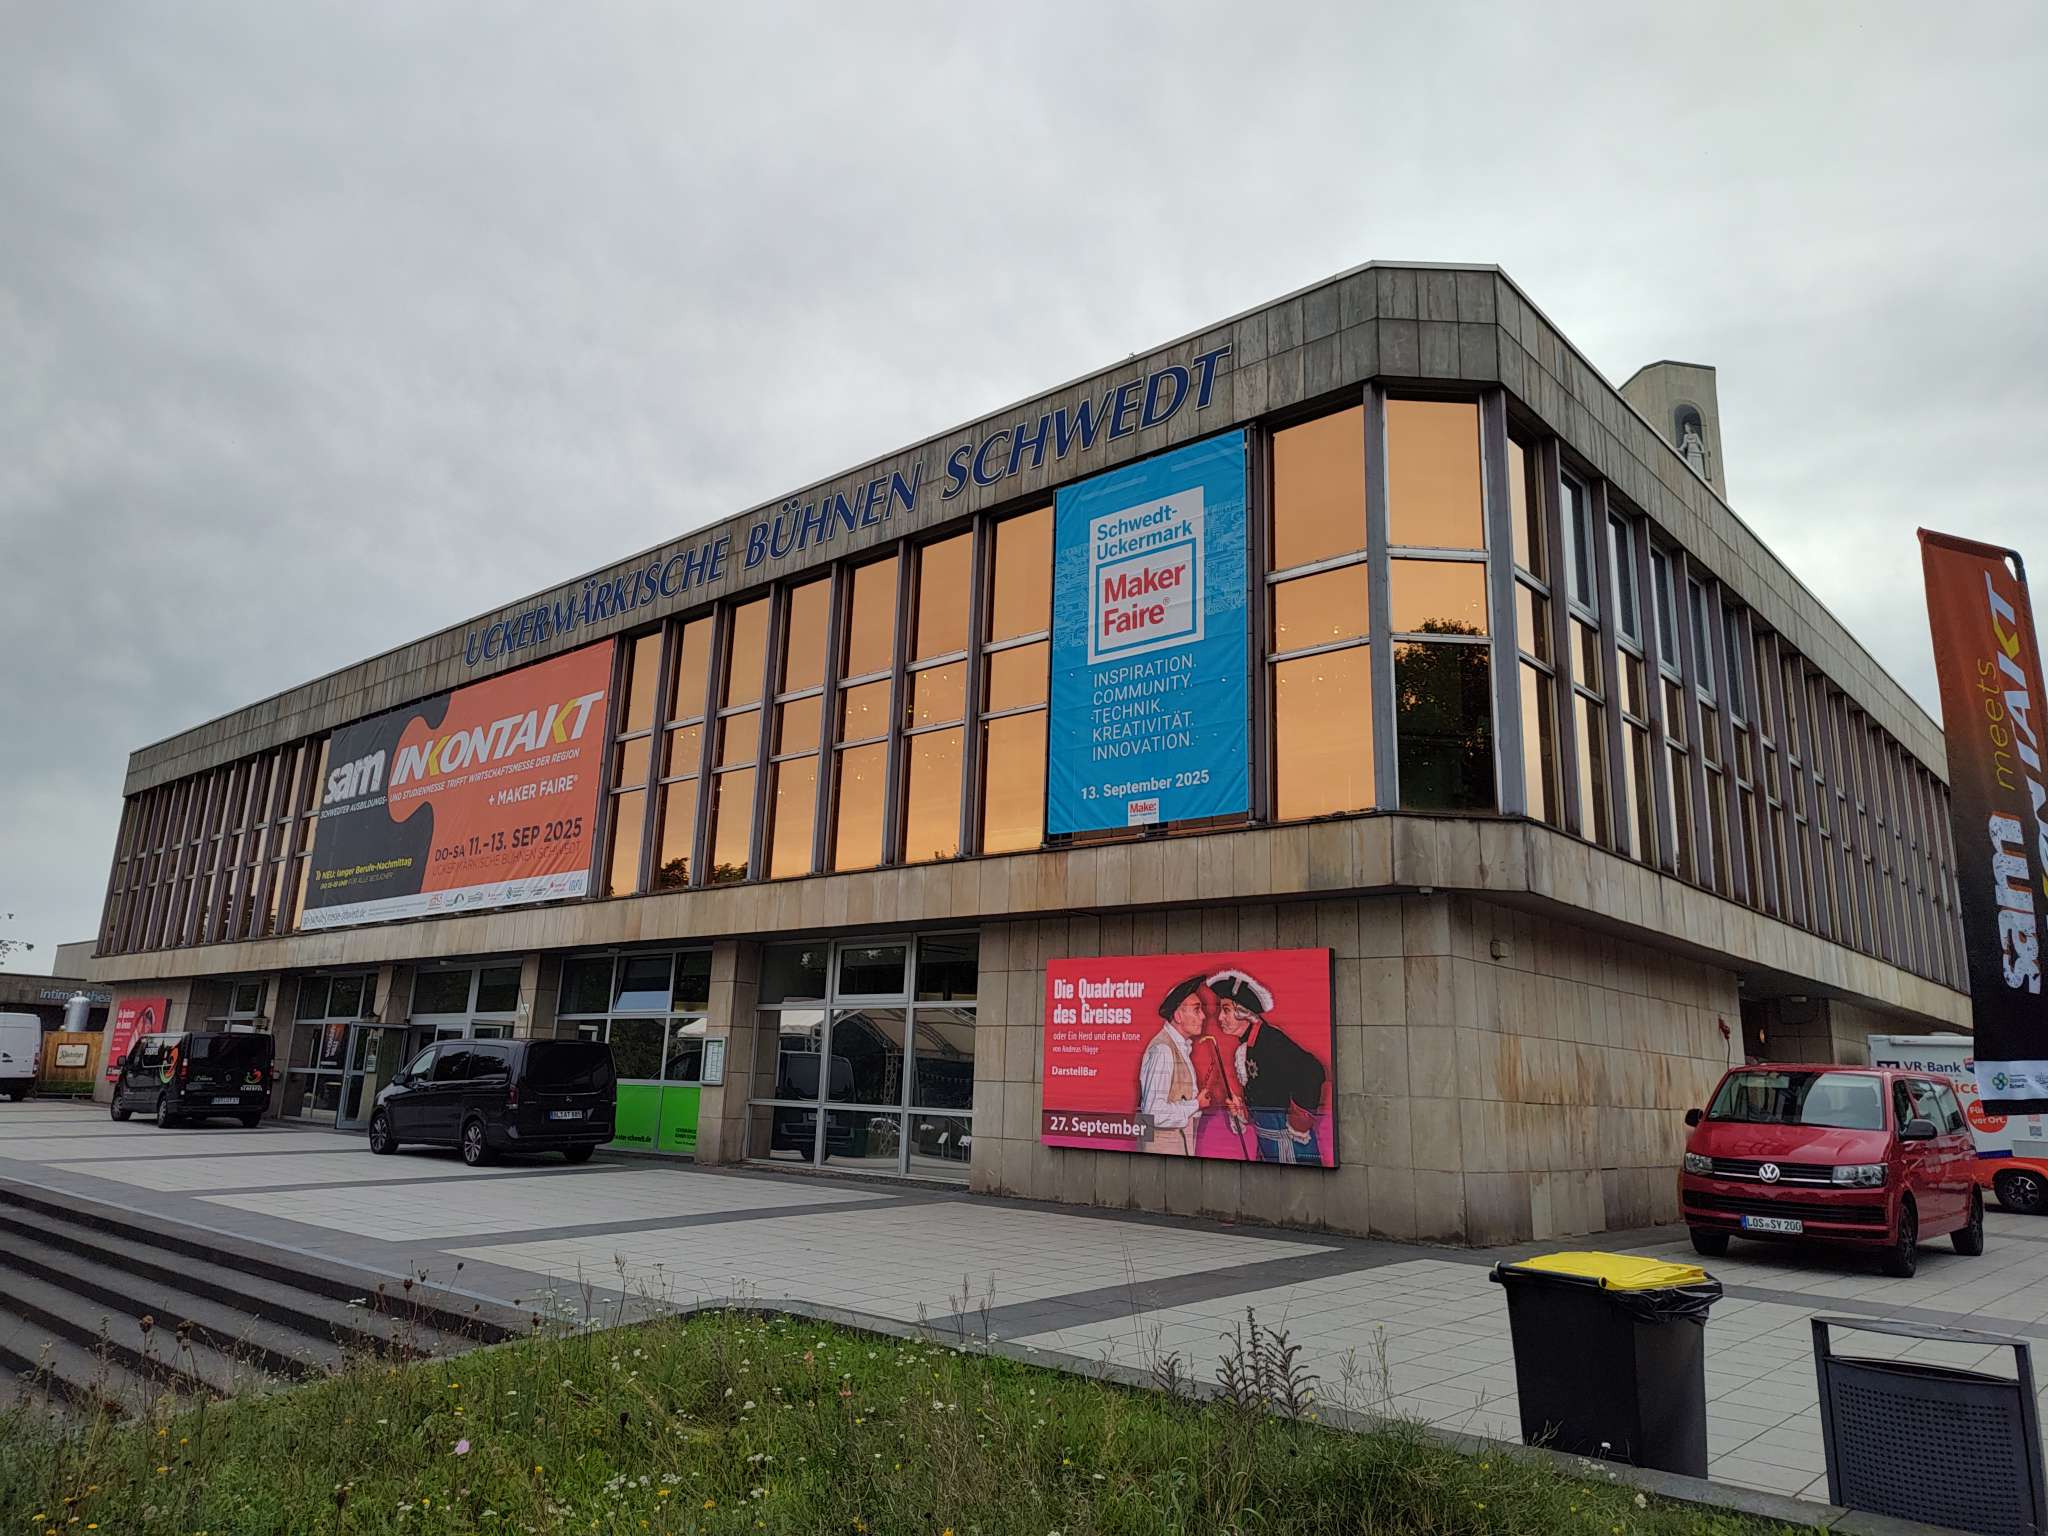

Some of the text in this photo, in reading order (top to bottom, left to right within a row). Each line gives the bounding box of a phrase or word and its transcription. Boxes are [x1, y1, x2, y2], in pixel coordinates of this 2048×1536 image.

[464, 343, 1232, 667] UCKERMÄRKISCHE BÜHNEN SCHWEDT
[1097, 504, 1177, 541] Schwedt-
[1096, 520, 1192, 560] Uckermark
[1104, 563, 1186, 604] Maker
[1094, 653, 1196, 688] INSPIRATION.
[1093, 672, 1193, 706] COMMUNITY.
[1093, 698, 1164, 724] TECHNIK.
[1093, 710, 1194, 742] KREATIVITÄT.
[390, 690, 605, 787] INKONTAKT
[1093, 731, 1194, 761] INNOVATION.
[535, 754, 551, 768] DER
[551, 748, 581, 764] REGION
[324, 749, 386, 804] sam
[1081, 769, 1210, 800] 13. September 2025
[497, 783, 537, 806] MAKER
[434, 845, 465, 862] DO-SA
[512, 825, 540, 848] SEP
[544, 817, 583, 843] 2025
[1977, 658, 2041, 995] sam meets
[1054, 977, 1144, 1003] Die Quadratur
[1053, 1003, 1132, 1024] des Greises
[1053, 1030, 1140, 1041] oder Ein Herd und eine Krone
[1062, 1045, 1082, 1053] Andreas
[1051, 1066, 1097, 1076] DarstellBar
[1955, 1080, 1979, 1094] ice
[1050, 1116, 1147, 1136] 27. September
